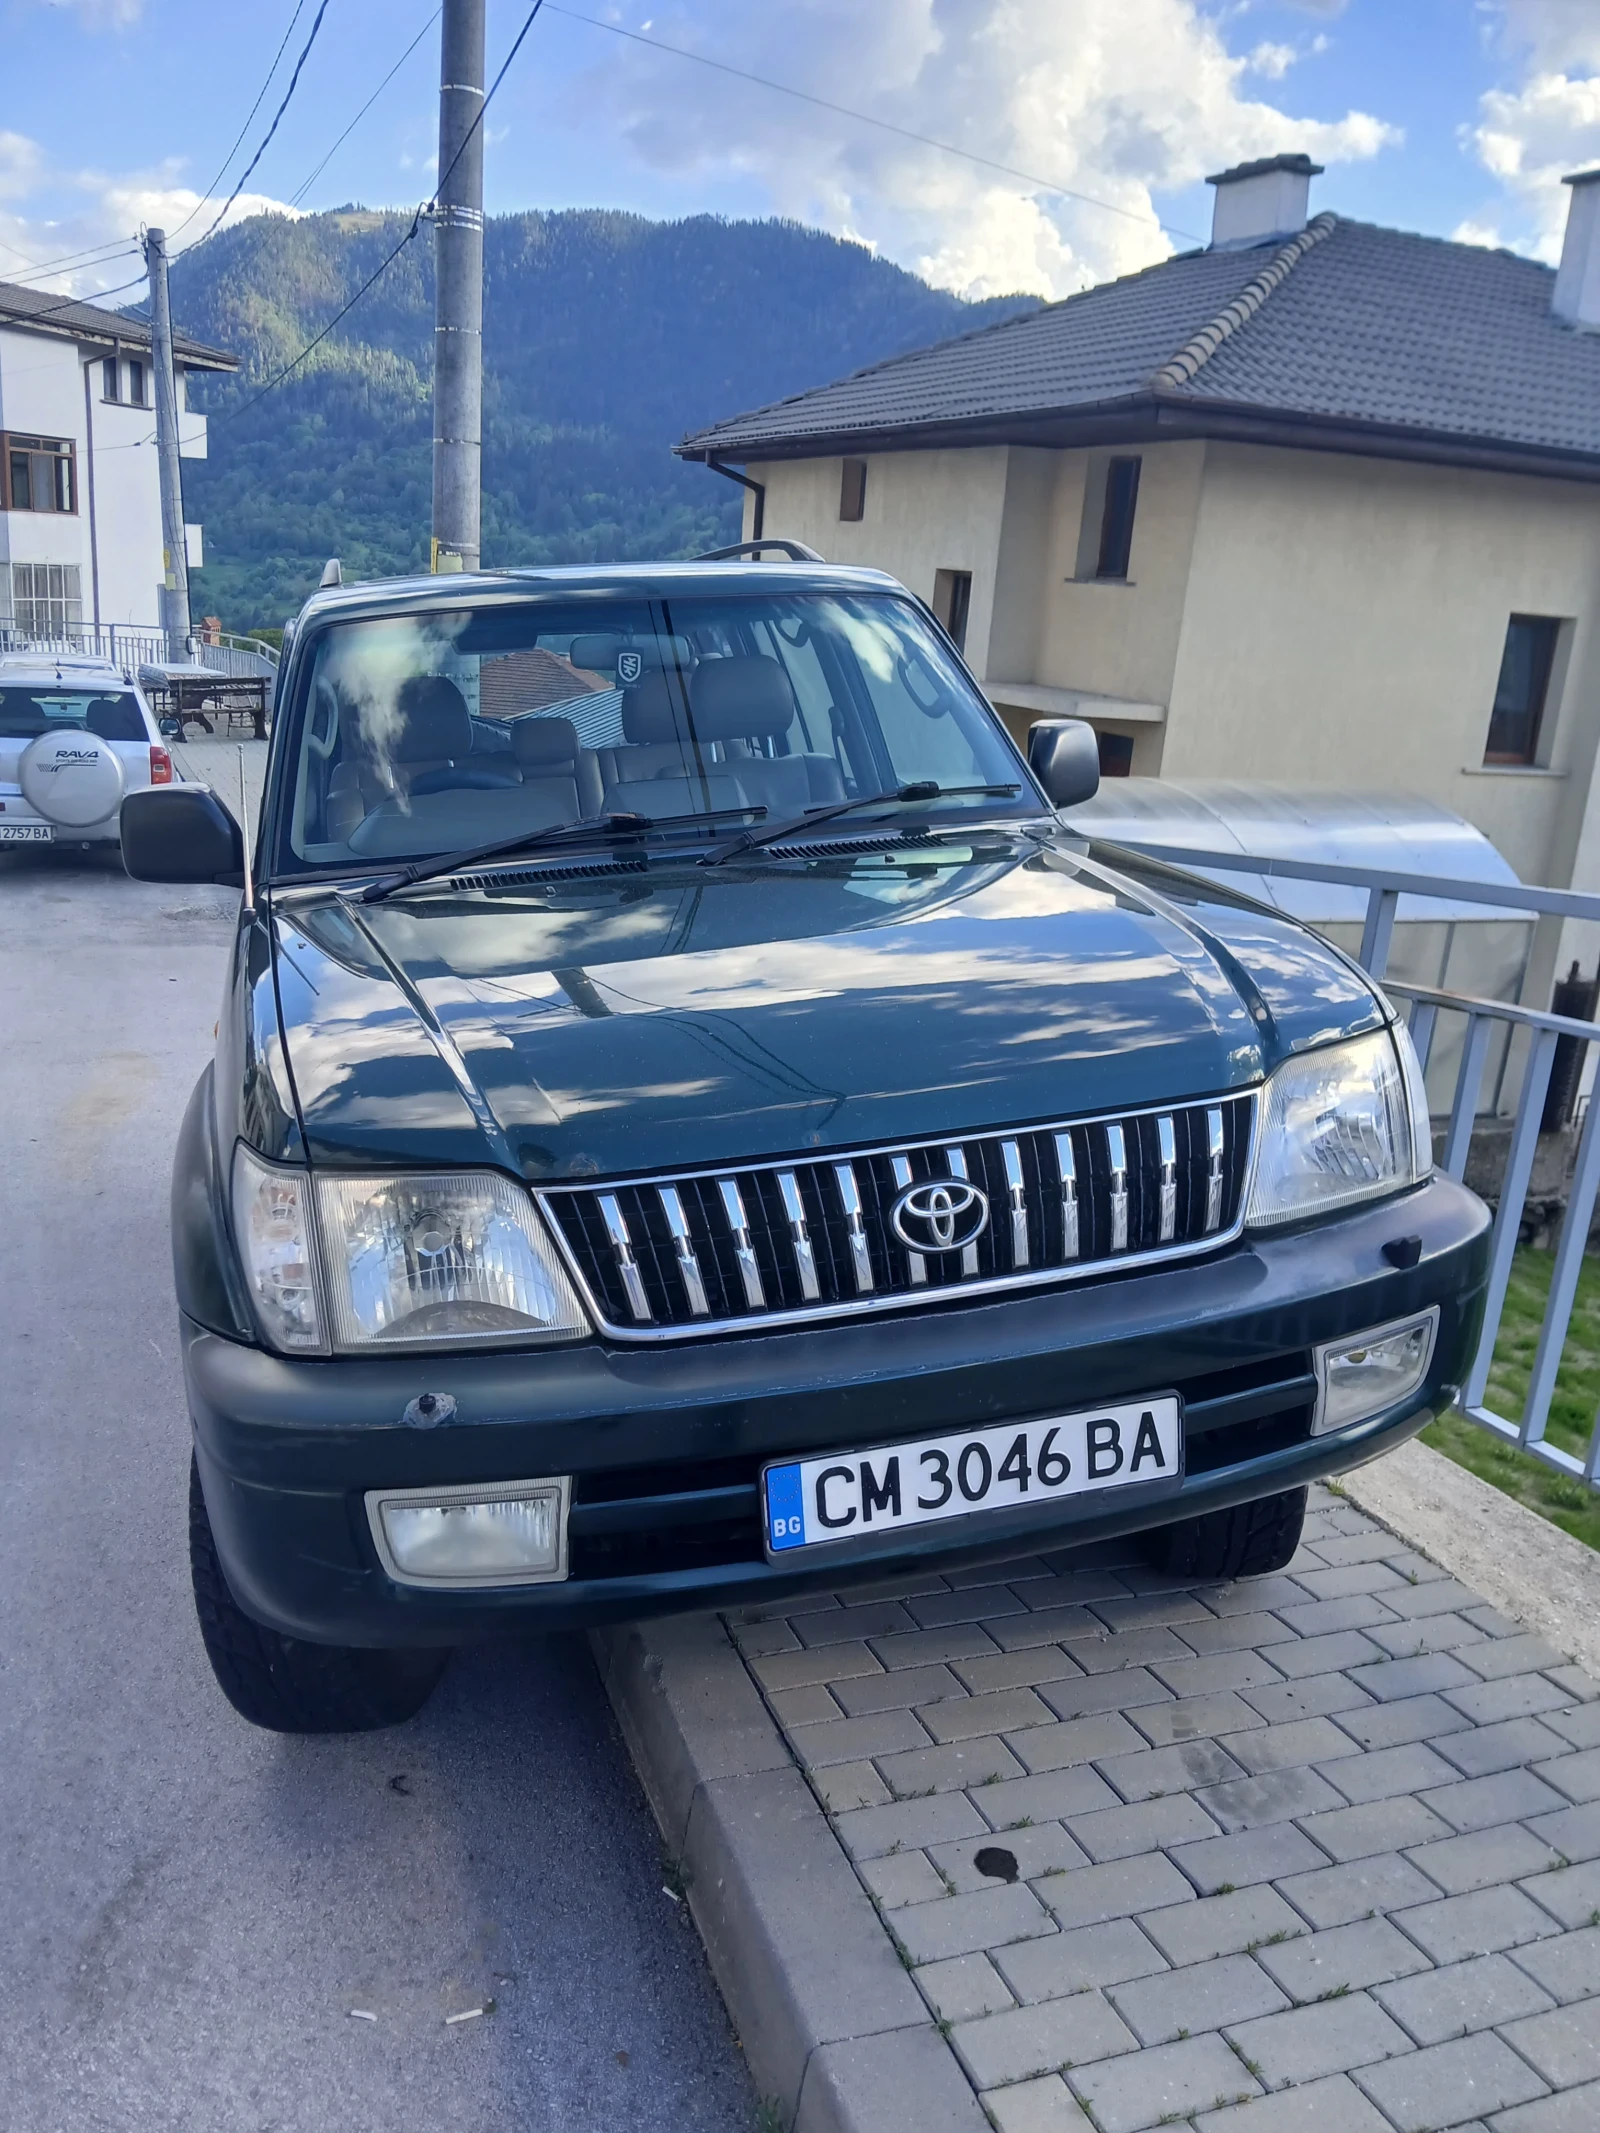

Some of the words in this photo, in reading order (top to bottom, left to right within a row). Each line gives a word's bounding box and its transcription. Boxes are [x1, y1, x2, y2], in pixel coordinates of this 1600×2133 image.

[55, 750, 99, 758] RAV4
[3, 827, 31, 839] 2757
[33, 828, 49, 839] BA
[815, 1456, 901, 1528] CM
[917, 1427, 1071, 1509] 3046
[1086, 1411, 1166, 1480] BA
[773, 1516, 801, 1538] BG
